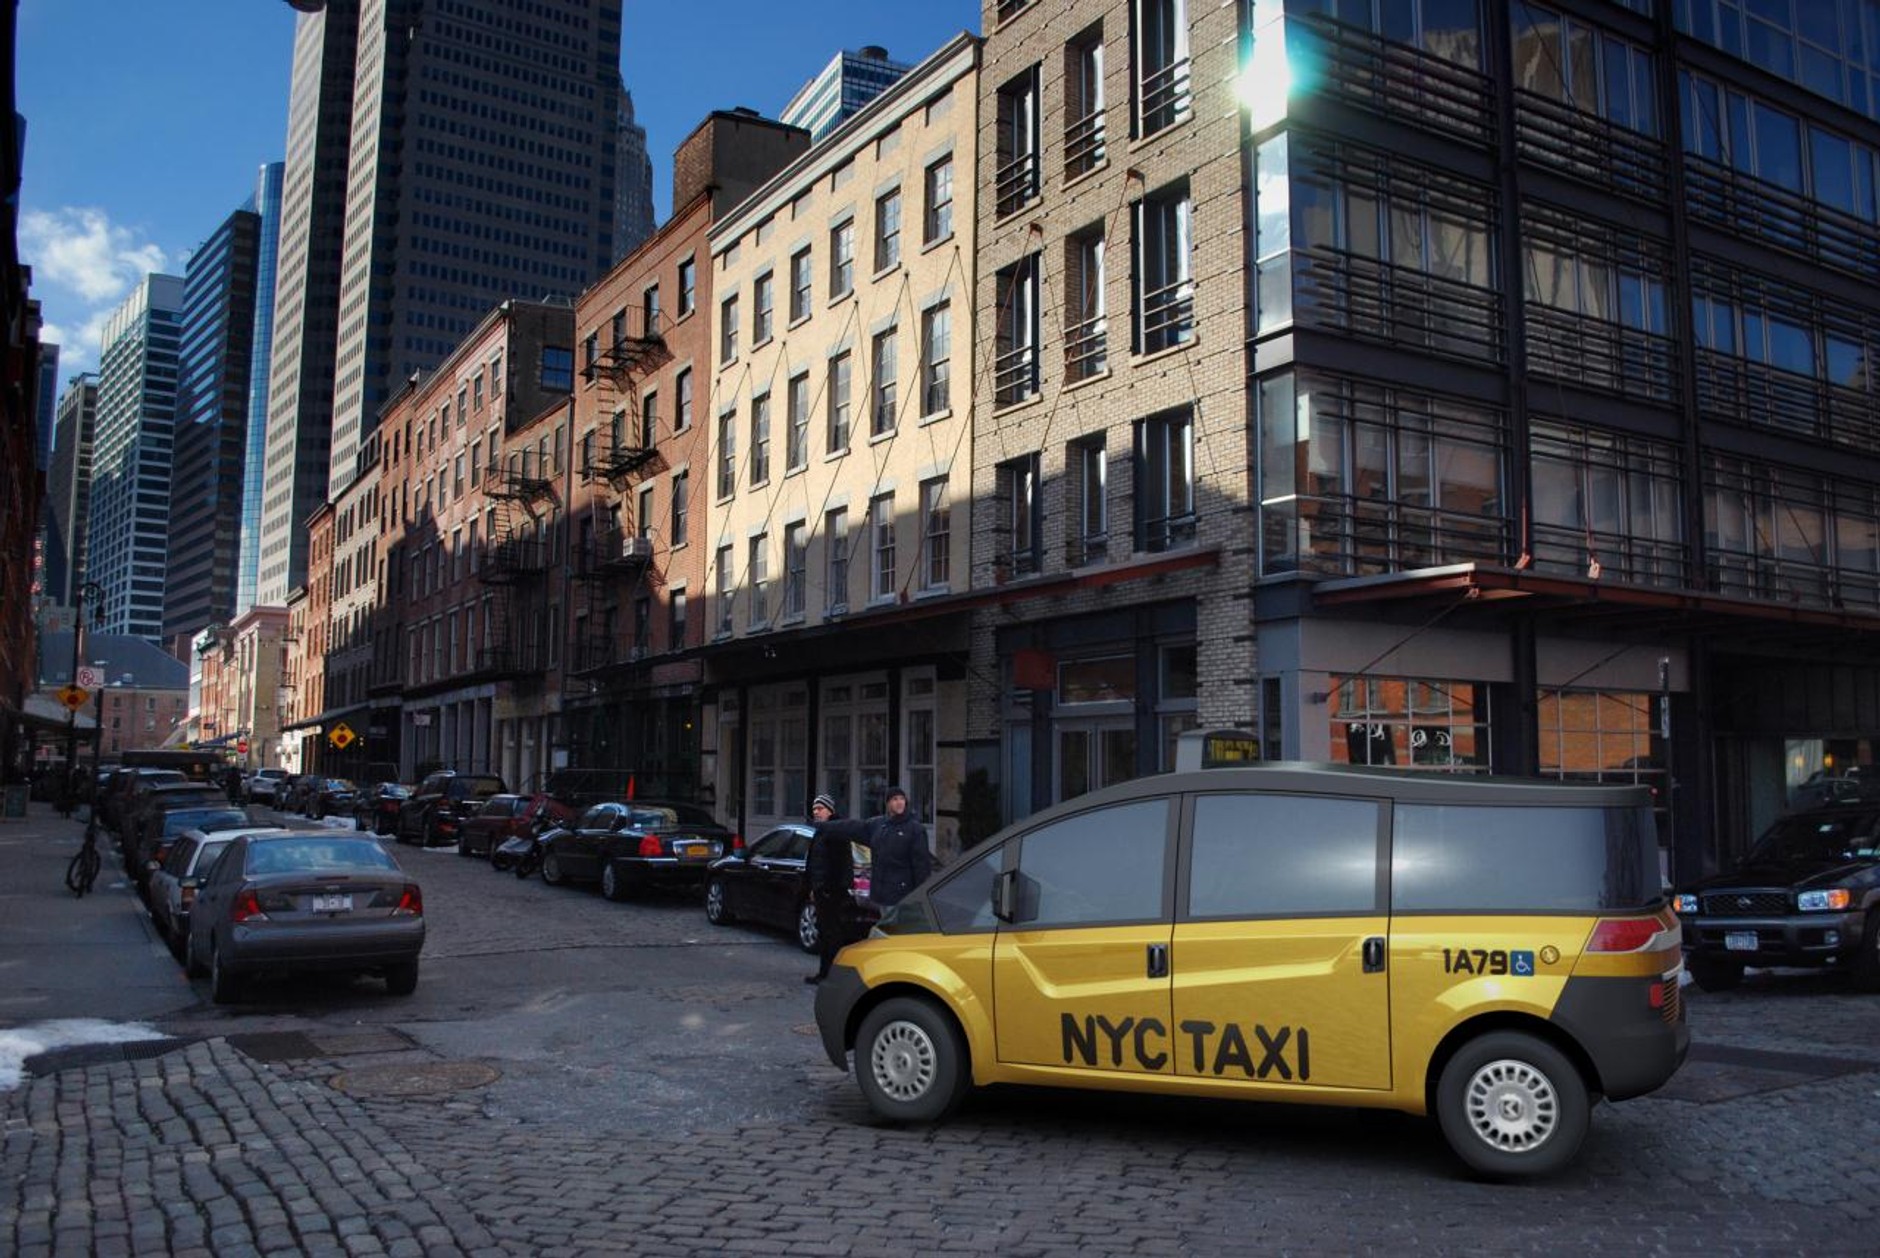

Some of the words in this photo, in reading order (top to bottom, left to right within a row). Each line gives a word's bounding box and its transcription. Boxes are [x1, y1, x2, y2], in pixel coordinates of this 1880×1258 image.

[1442, 948, 1508, 975] 1A79
[1061, 1012, 1168, 1071] NYC
[1179, 1020, 1310, 1081] TAXI
